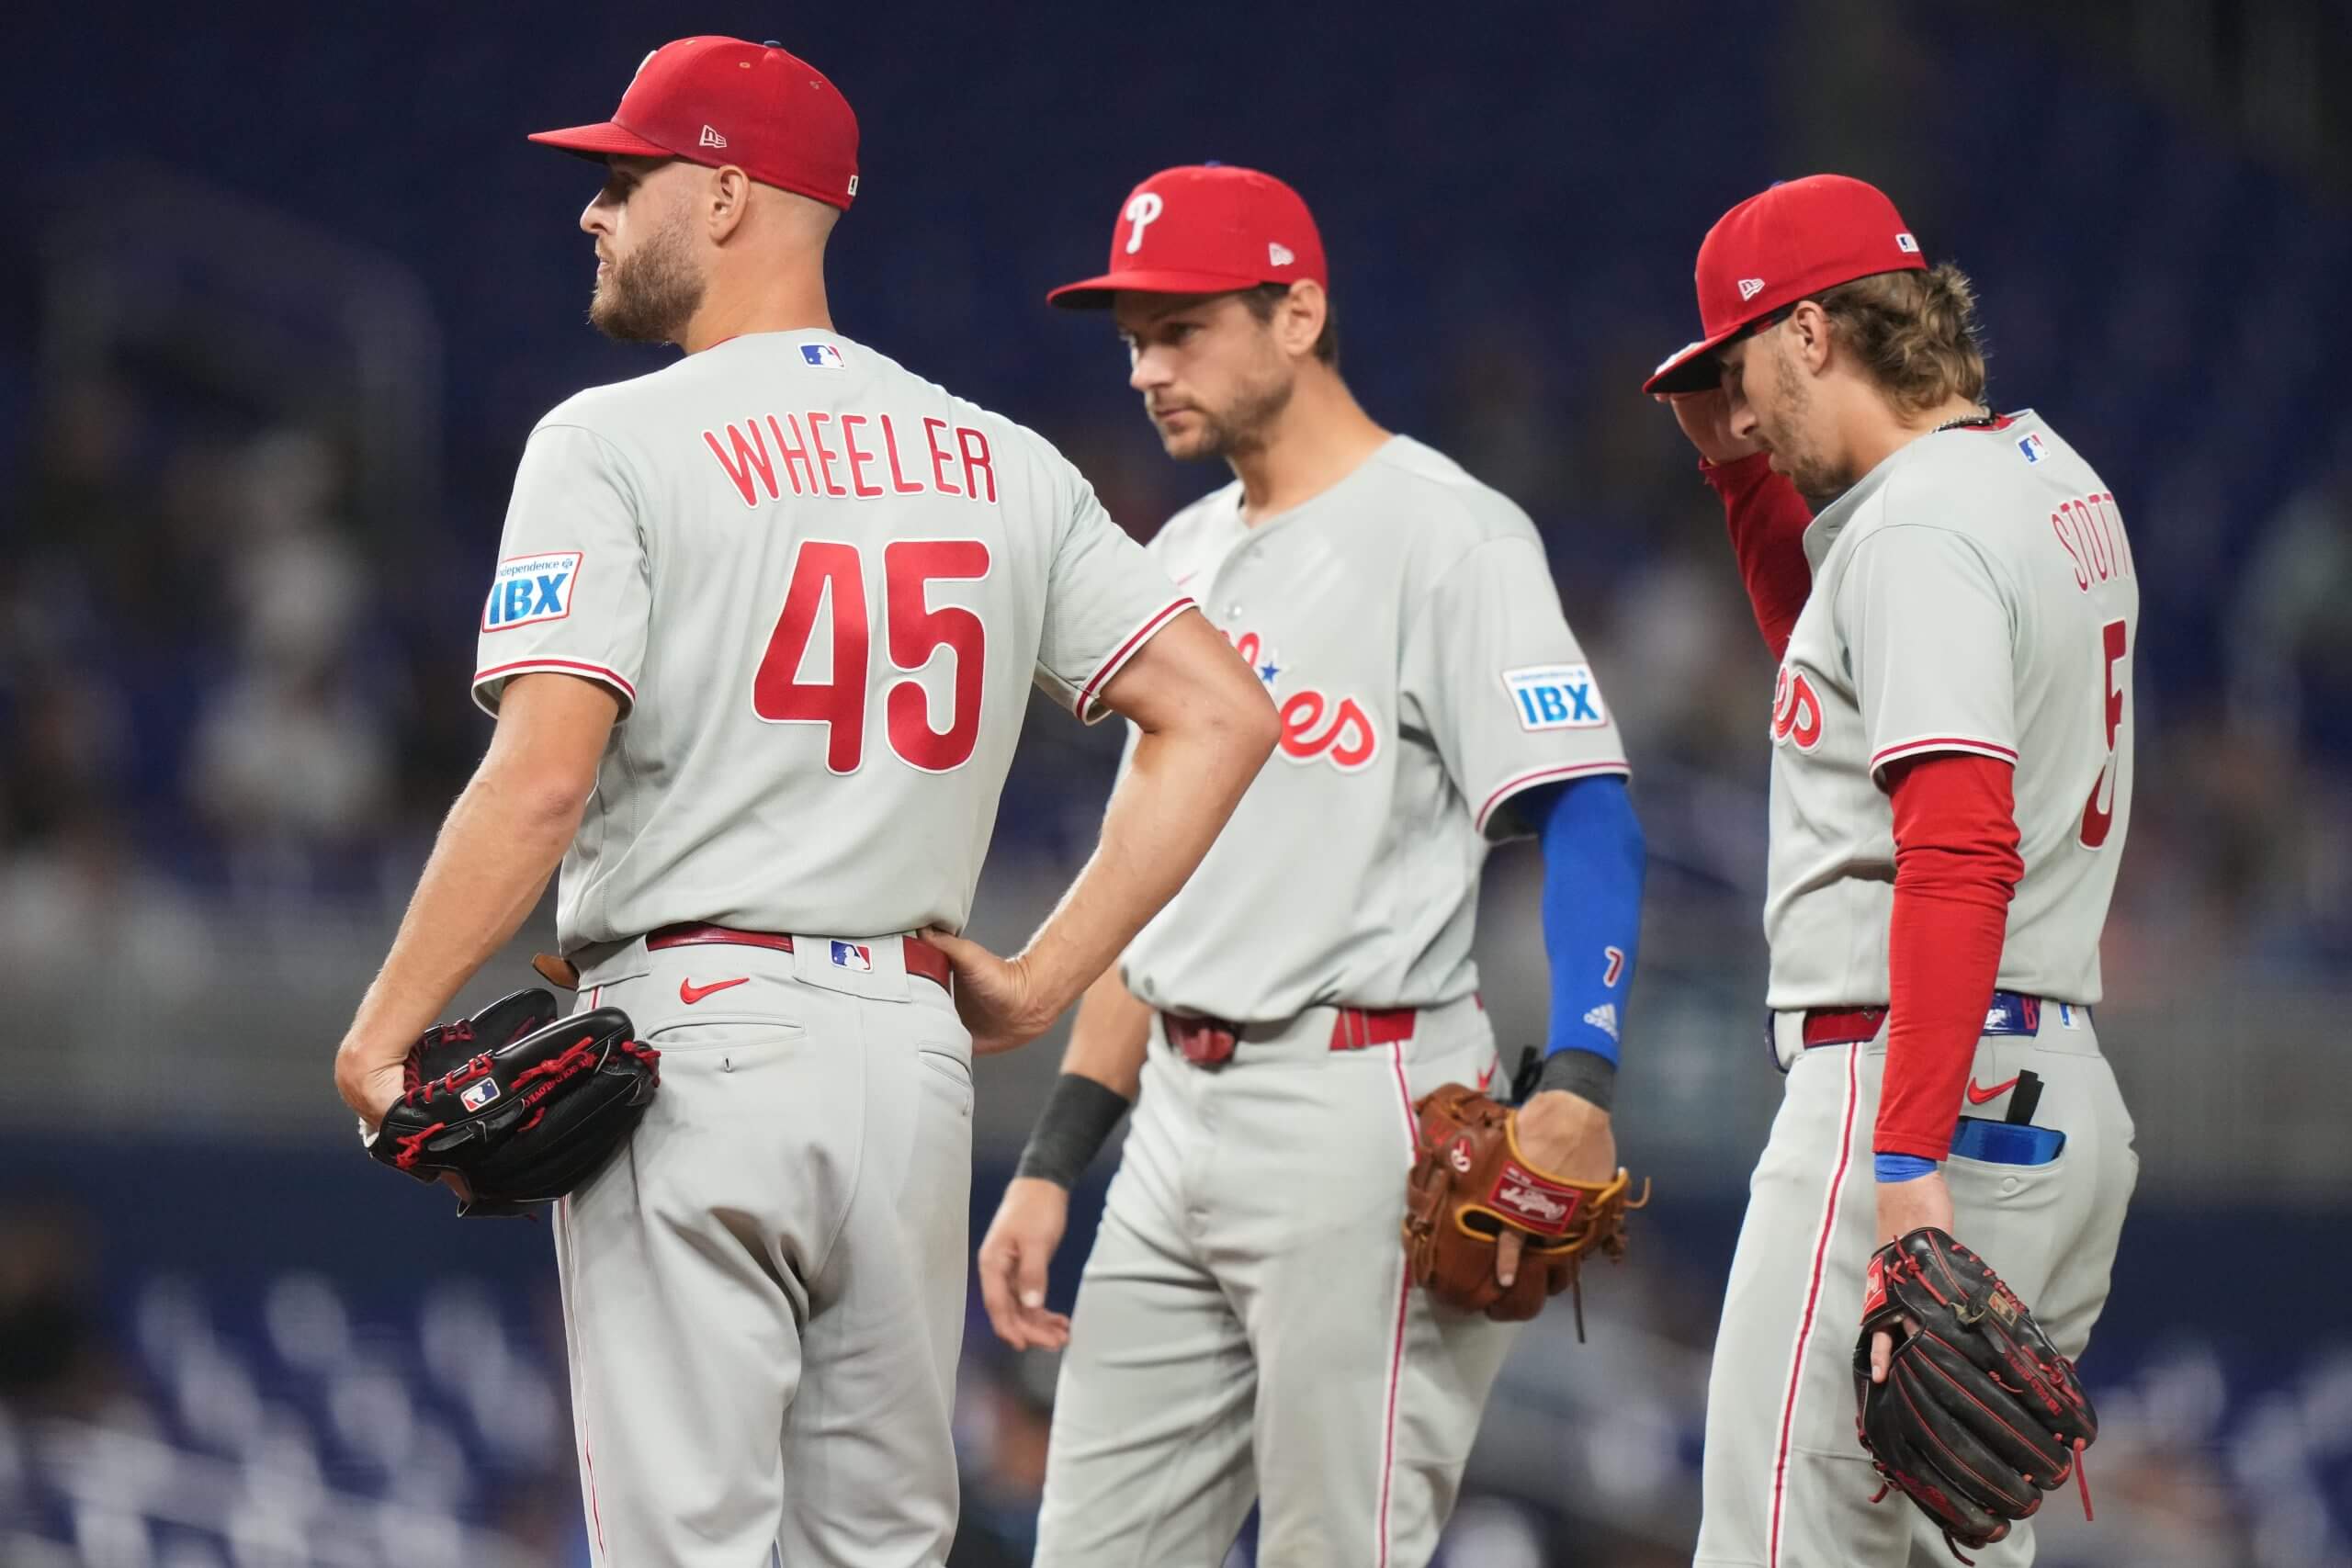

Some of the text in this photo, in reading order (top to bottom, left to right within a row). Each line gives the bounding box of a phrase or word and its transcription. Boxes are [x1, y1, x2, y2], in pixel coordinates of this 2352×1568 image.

[1125, 192, 1164, 254] P
[703, 412, 998, 509] WHEELER
[489, 573, 569, 626] IBX
[752, 537, 991, 776] 45
[1517, 683, 1600, 724] IBX
[2078, 618, 2127, 850] 5
[1603, 945, 1624, 987] 7
